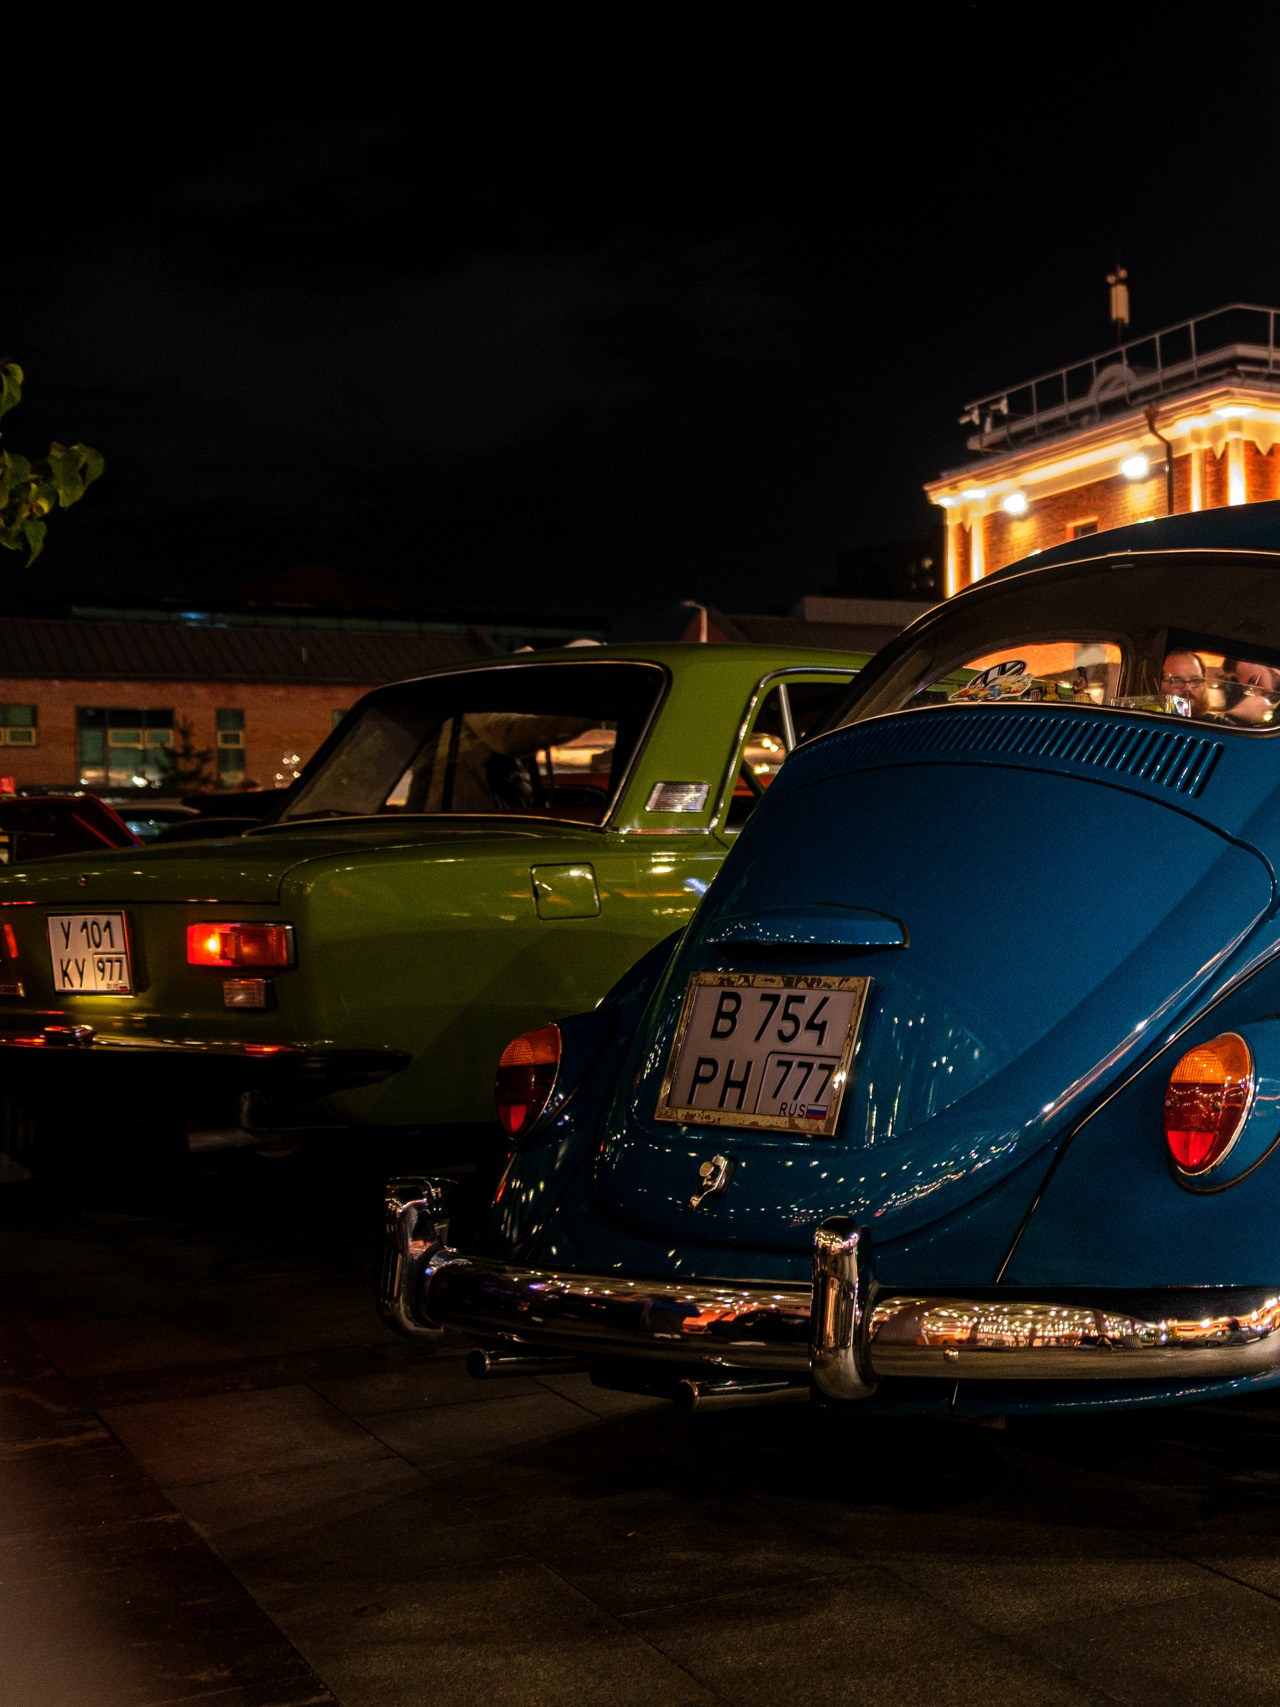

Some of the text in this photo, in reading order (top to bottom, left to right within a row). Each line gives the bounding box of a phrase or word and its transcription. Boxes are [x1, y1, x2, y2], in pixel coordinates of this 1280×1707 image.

[80, 920, 114, 950] 101
[97, 957, 123, 981] 977
[754, 993, 831, 1046] 754
[772, 1060, 836, 1103] 777
[779, 1103, 806, 1117] RUS
